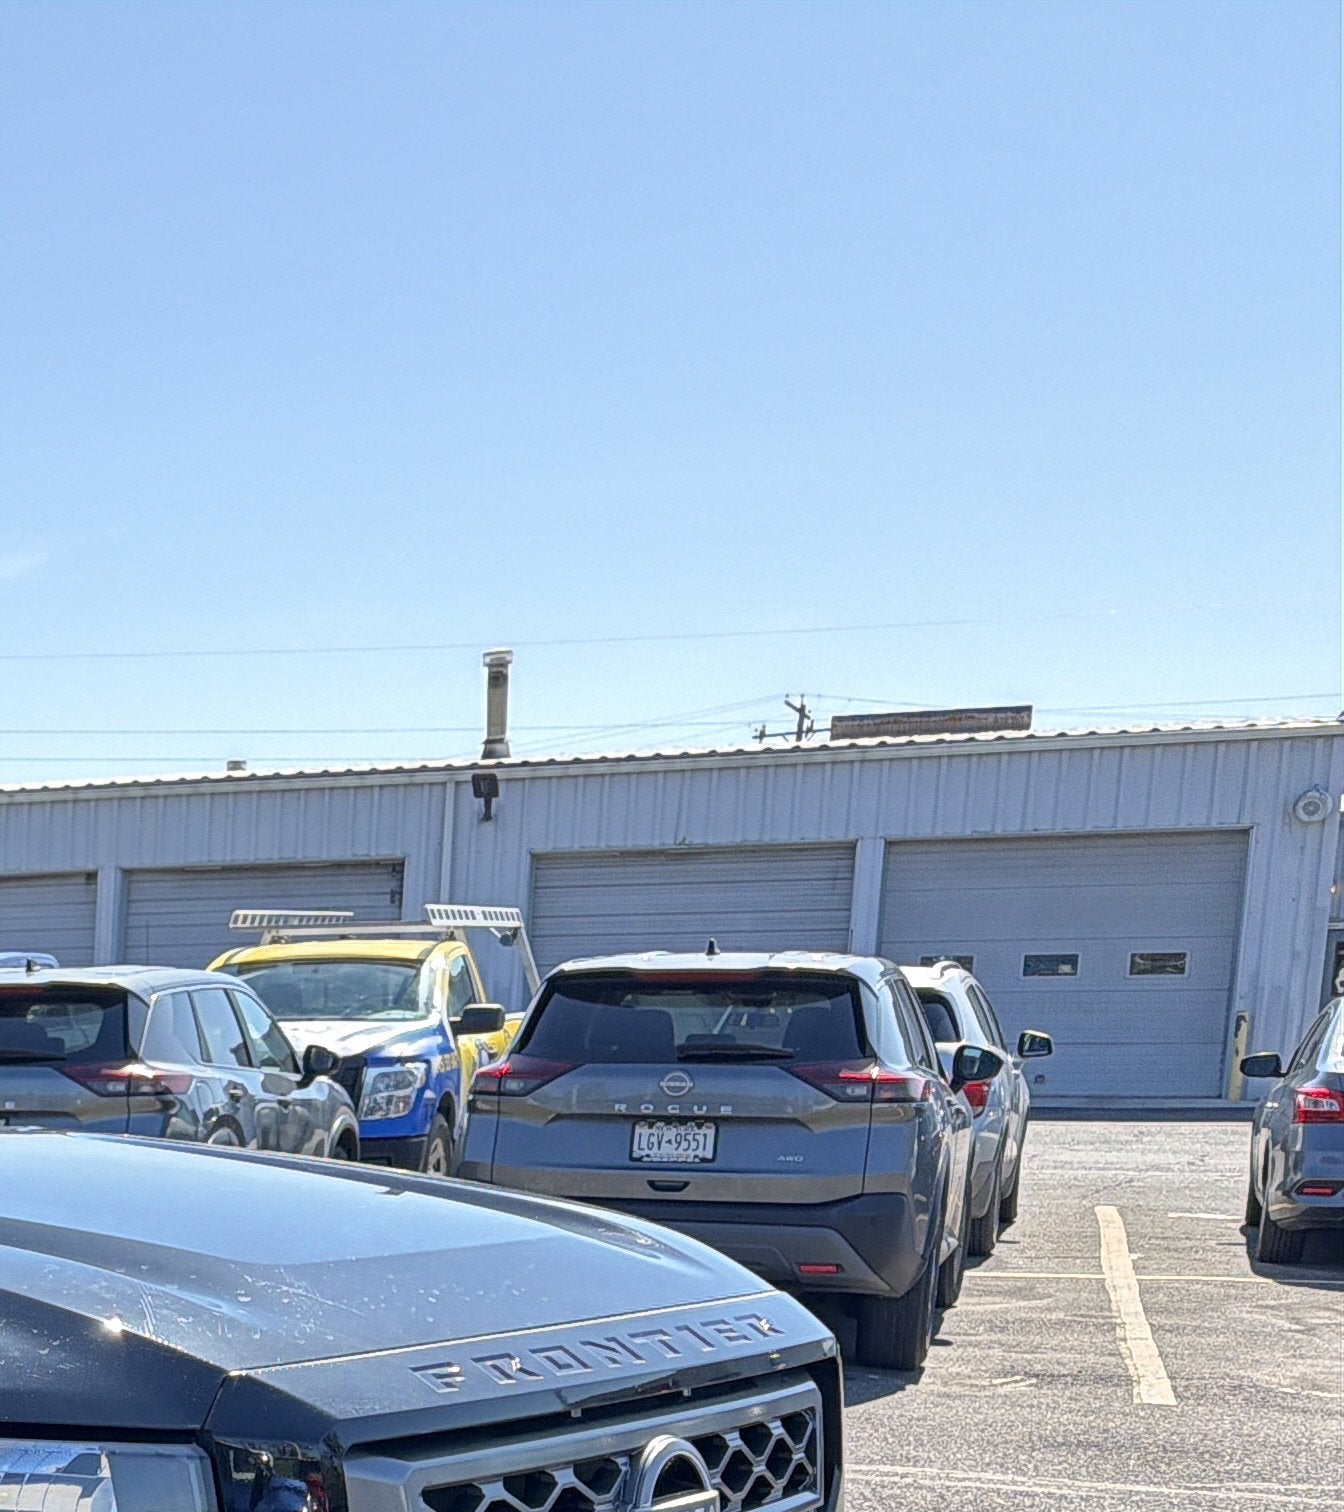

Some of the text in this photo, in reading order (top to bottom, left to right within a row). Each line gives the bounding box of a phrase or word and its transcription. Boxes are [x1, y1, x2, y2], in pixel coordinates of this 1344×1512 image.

[614, 1103, 733, 1115] ROGUE
[674, 1132, 708, 1152] 9551
[408, 1312, 787, 1394] FRONTIER
